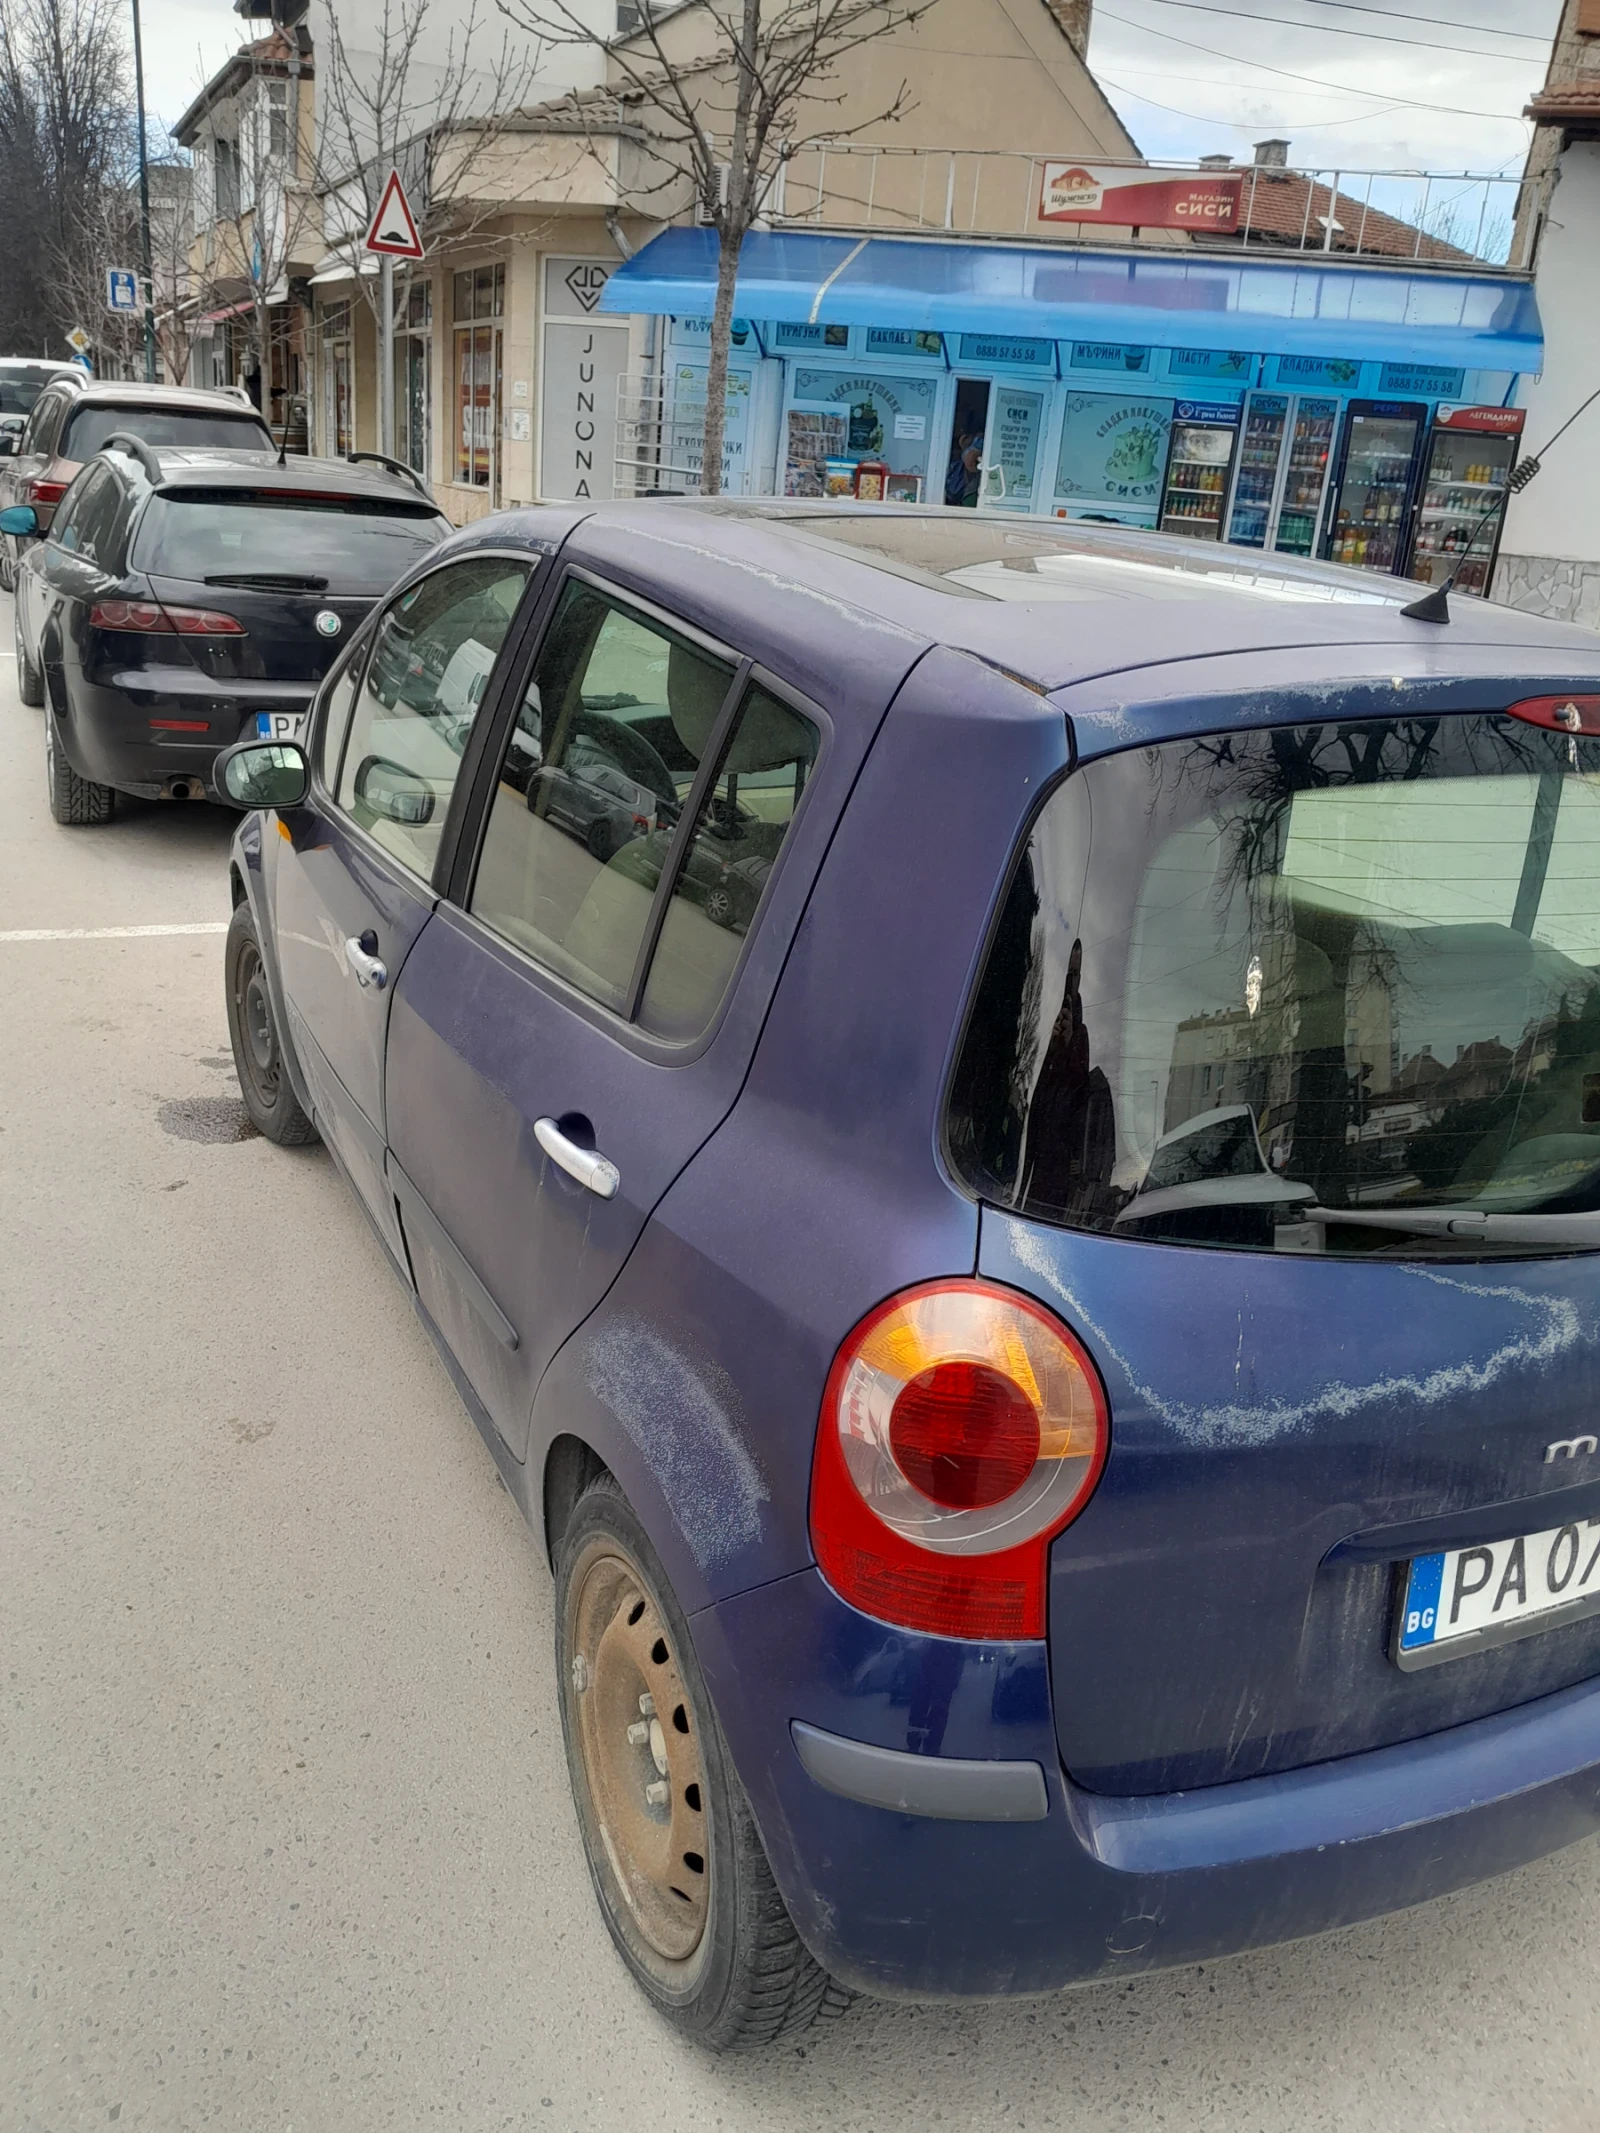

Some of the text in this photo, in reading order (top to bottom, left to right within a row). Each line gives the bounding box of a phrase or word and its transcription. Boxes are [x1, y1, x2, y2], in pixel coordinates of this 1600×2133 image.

[1051, 193, 1097, 206] Шуменско
[1189, 193, 1234, 203] МАГАЗИН
[1175, 202, 1232, 218] СИСИ
[685, 320, 713, 333] МЪФИ
[781, 324, 821, 339] ТРИГУНИ
[870, 330, 912, 345] БАКЛАВА
[976, 345, 1036, 360] 0888 57 55 58
[1077, 345, 1121, 361] МЪФИНИ
[1178, 351, 1211, 366] ПАСТИ
[1282, 356, 1323, 373] СЛАДКИ
[1388, 377, 1453, 393] 0888 57 55 58
[1256, 398, 1282, 408] DEVIN
[1305, 402, 1330, 412] DEVIN
[575, 333, 595, 499] JUNONA
[1406, 1607, 1435, 1634] BG
[1449, 1536, 1527, 1626] PA
